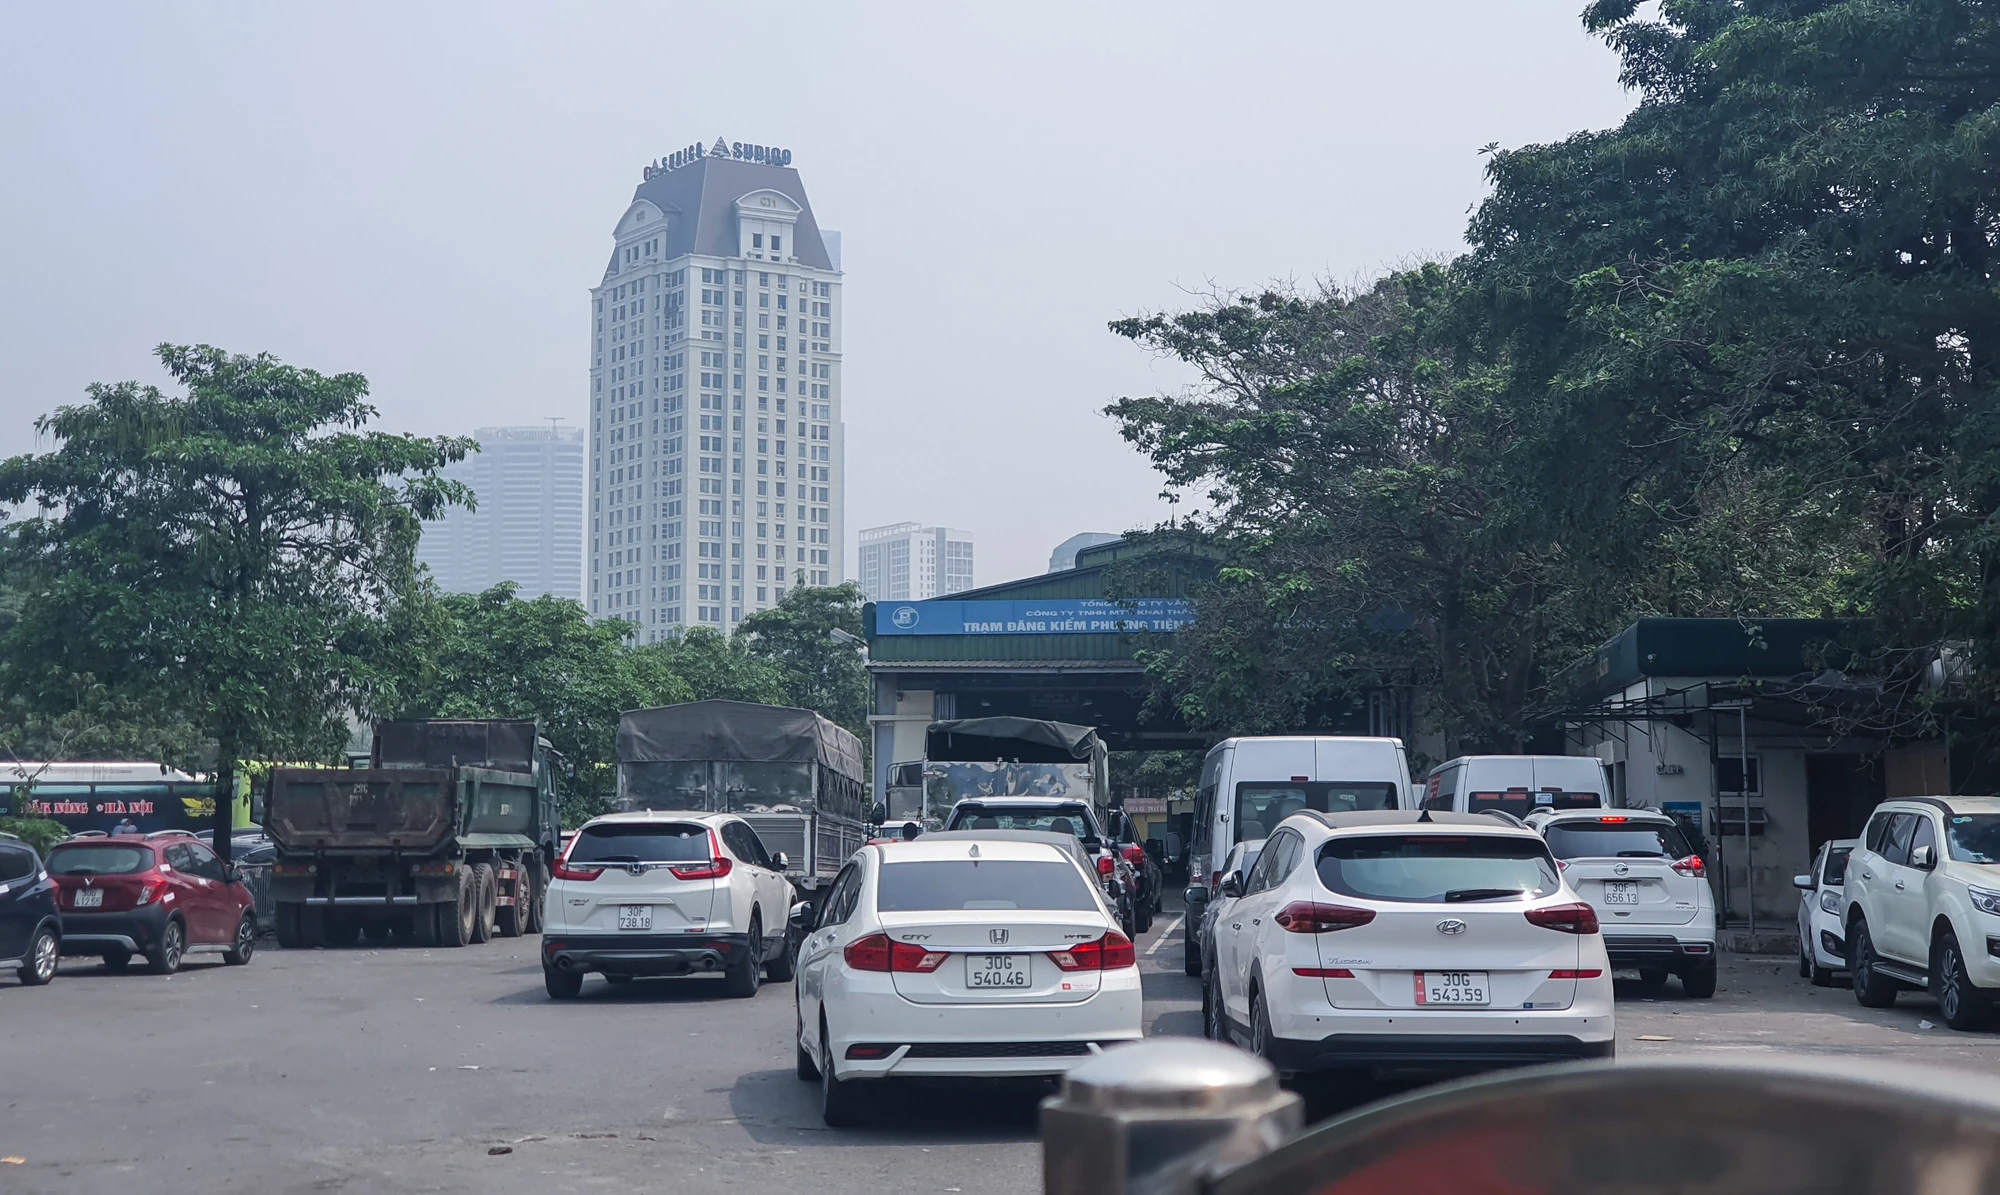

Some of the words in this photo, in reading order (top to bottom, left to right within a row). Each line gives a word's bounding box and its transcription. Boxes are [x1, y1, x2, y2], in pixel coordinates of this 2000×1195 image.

[1025, 609, 1058, 617] CÔNG
[963, 622, 1003, 634] TRẠM
[1007, 619, 1046, 632] ĐĂNG
[1050, 617, 1087, 632] KIỂM
[53, 798, 89, 814] NÔNG
[104, 799, 127, 814] HÀ
[129, 798, 154, 817] NỘI
[1612, 882, 1629, 893] 30F
[1606, 893, 1637, 903] 656.13
[627, 906, 645, 917] 30F
[620, 917, 651, 928] 738.18
[985, 956, 1012, 970] 30G
[973, 971, 1024, 986] 540.46
[1442, 973, 1471, 987] 30G
[1432, 988, 1483, 1002] 543.59
